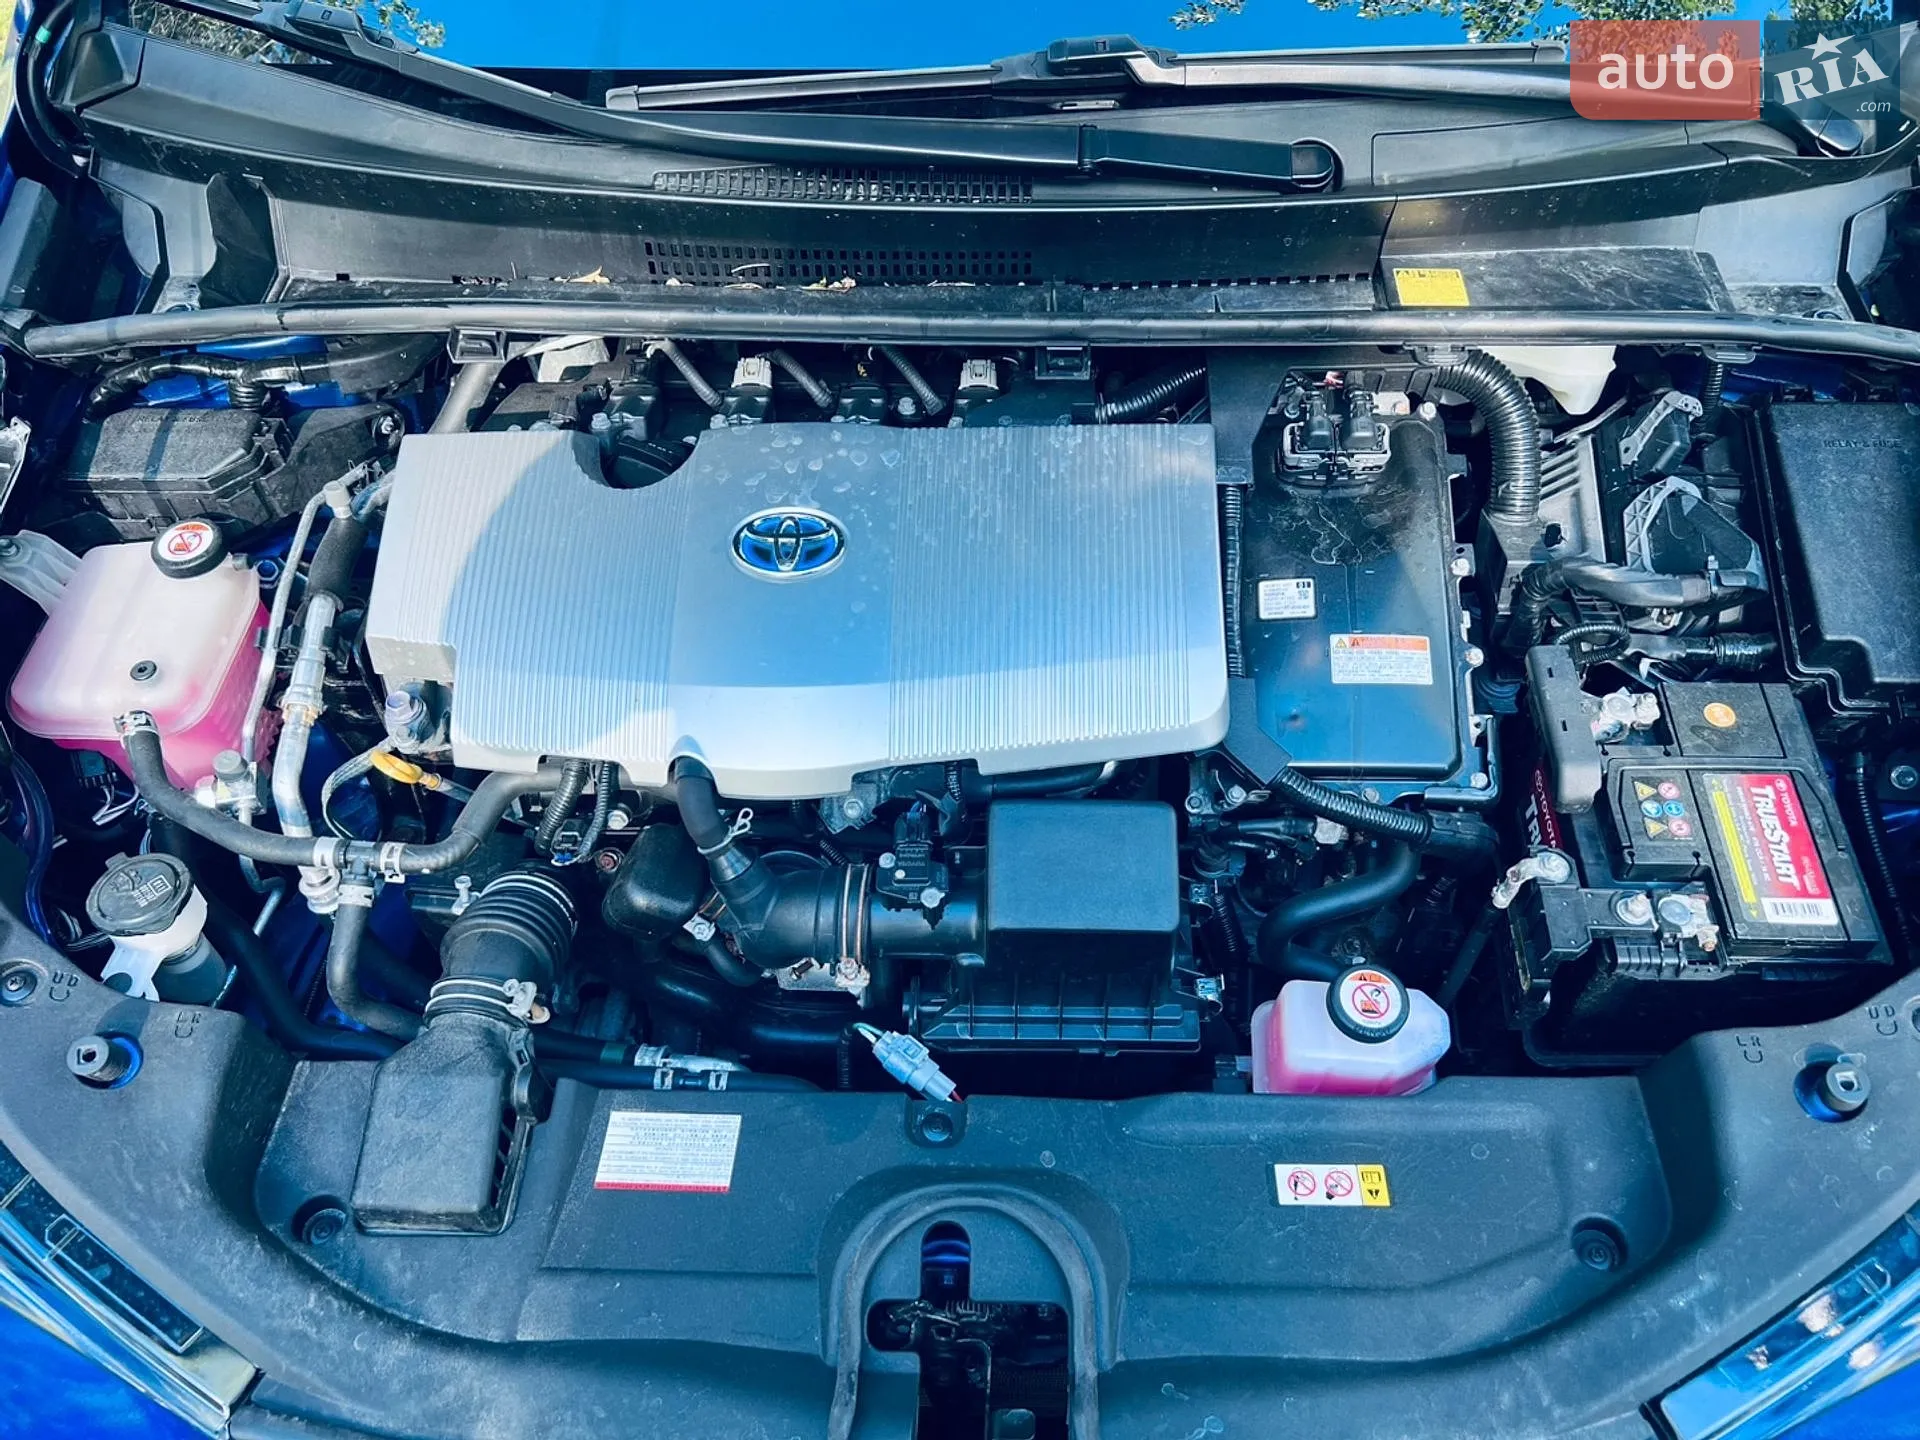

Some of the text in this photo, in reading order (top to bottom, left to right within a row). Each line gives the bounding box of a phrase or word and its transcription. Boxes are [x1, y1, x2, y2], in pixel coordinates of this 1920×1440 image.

[1823, 439, 1857, 448] RELAY
[1873, 439, 1903, 448] FUSE
[1780, 791, 1798, 827] TOYOTA
